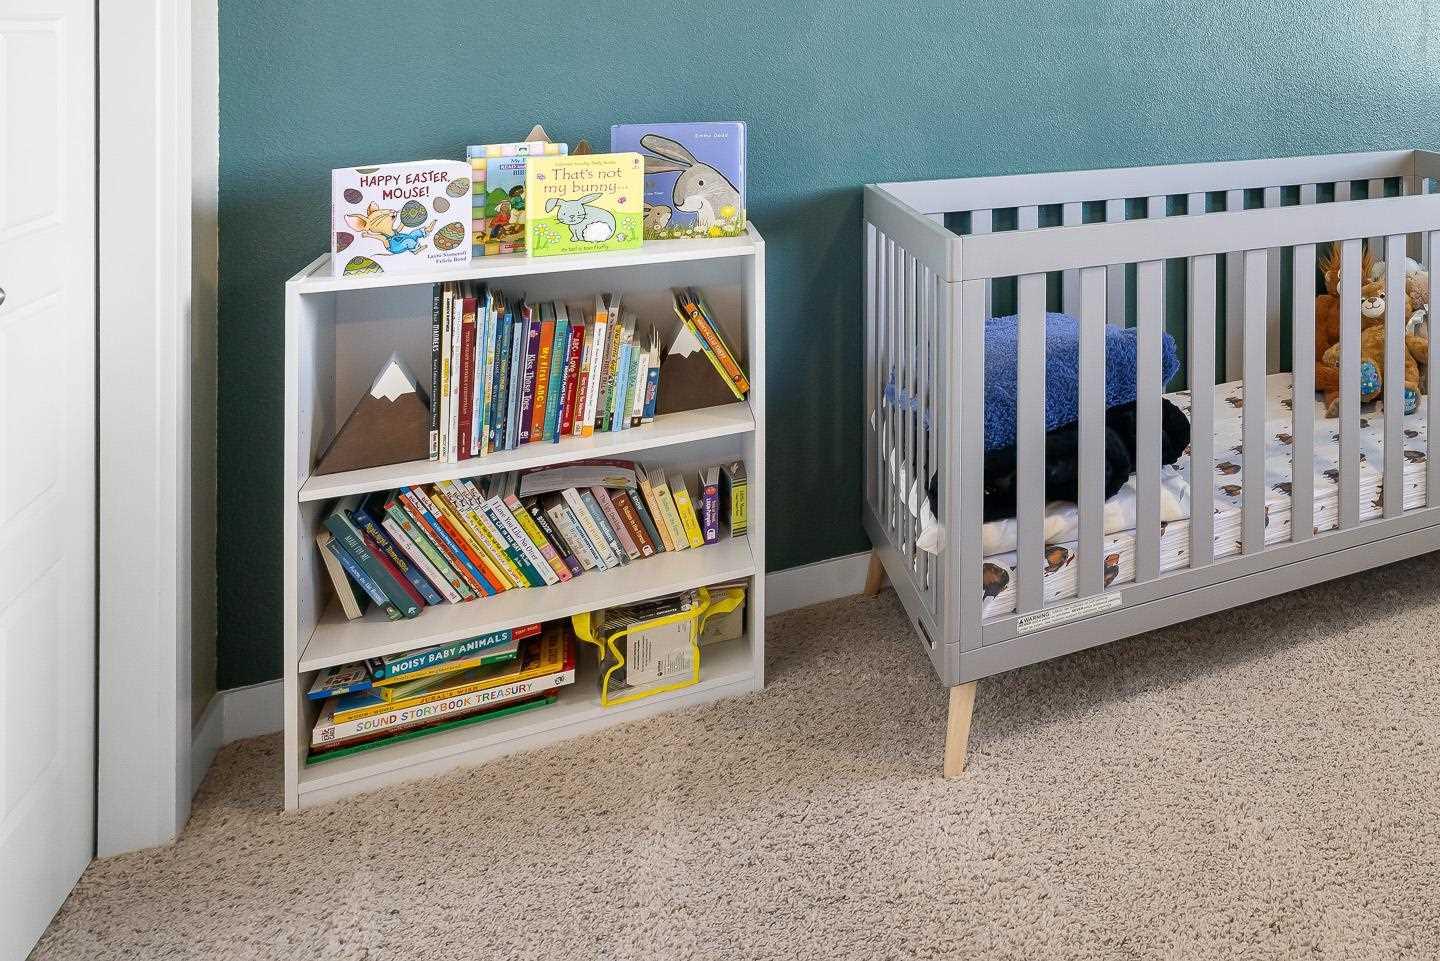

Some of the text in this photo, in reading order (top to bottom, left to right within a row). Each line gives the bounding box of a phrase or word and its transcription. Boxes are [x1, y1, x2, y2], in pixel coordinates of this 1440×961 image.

[360, 171, 451, 187] HAPPY EASTER,
[552, 167, 623, 181] That's not
[382, 185, 430, 200] MOUSE!
[544, 184, 567, 196] my
[569, 356, 578, 373] Love
[601, 360, 609, 377] FIRST
[522, 353, 535, 410] Kiss Those Toes
[534, 345, 549, 408] My First ABC's
[631, 495, 643, 511] snow
[494, 503, 508, 518] Love
[503, 515, 515, 528] You
[511, 525, 524, 539] Like
[519, 536, 530, 547] No
[525, 544, 540, 561] Otter
[391, 659, 426, 675] NOISY
[427, 648, 456, 664] BABY
[459, 631, 509, 654] ANIMALS
[356, 714, 398, 733] SOUND
[401, 698, 471, 721] STORYBOOK
[476, 682, 533, 705] TREASURY
